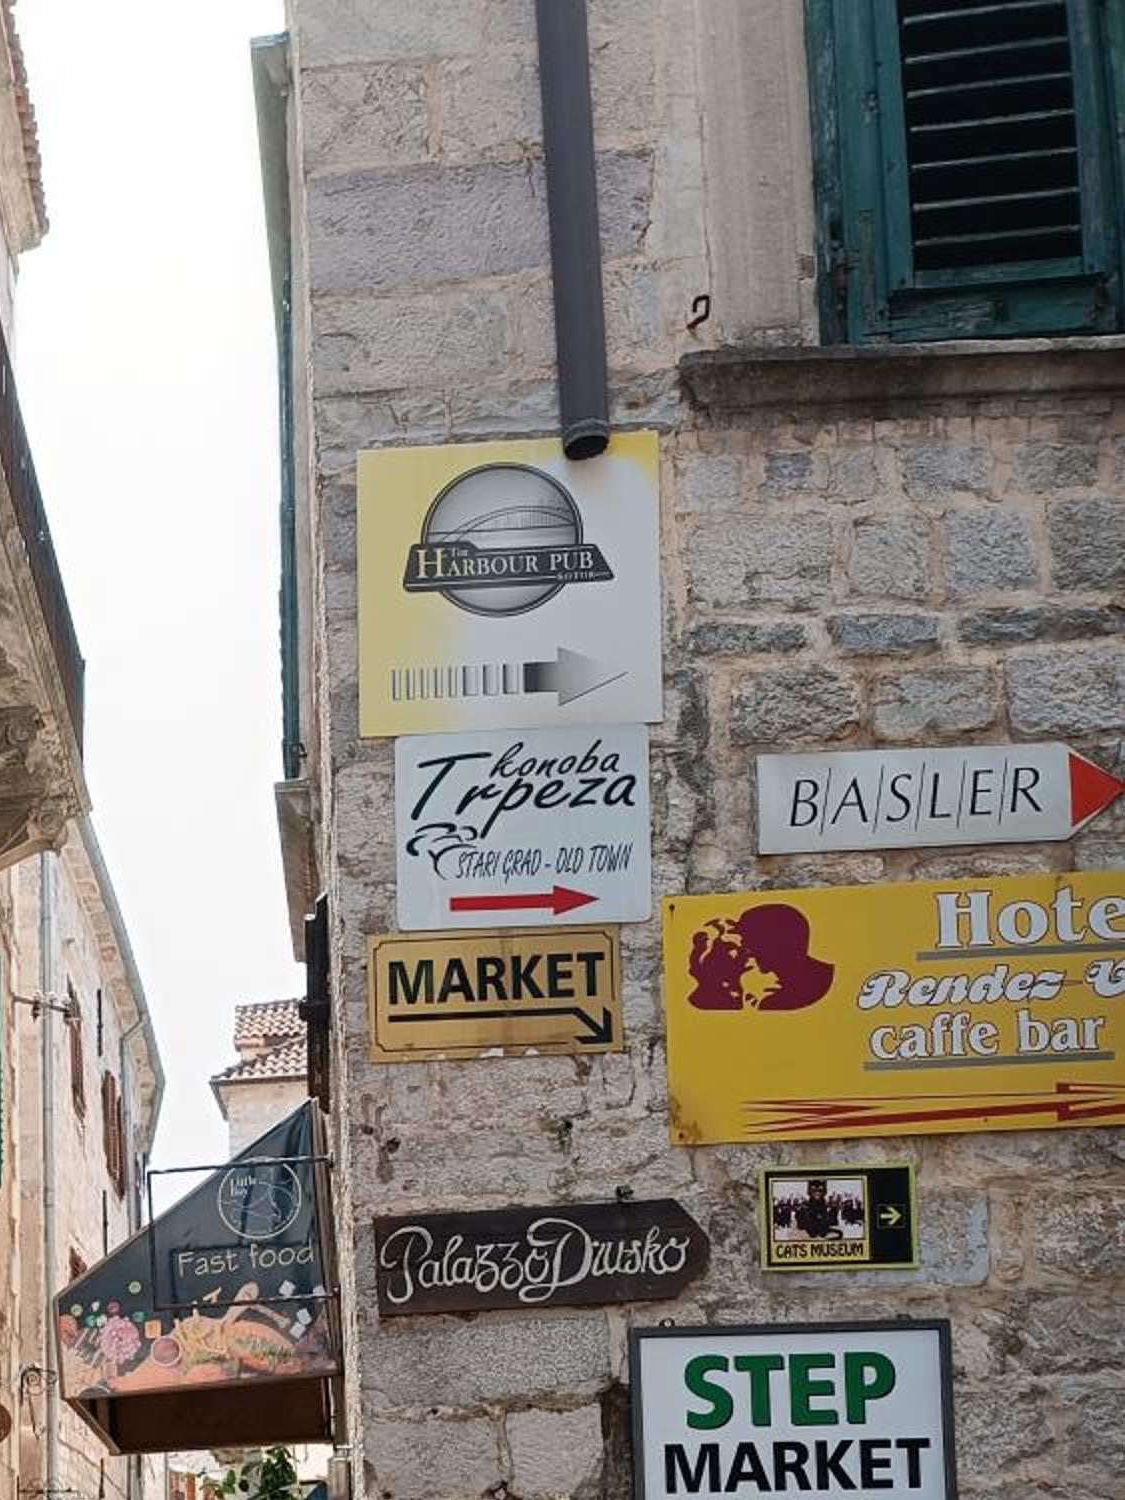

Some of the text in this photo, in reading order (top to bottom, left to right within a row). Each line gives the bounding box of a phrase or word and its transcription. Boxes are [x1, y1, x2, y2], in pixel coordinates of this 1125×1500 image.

[416, 548, 594, 579] HARBOUR PUB
[489, 740, 620, 779] konoba
[410, 752, 637, 839] Trpeza
[456, 850, 500, 879] STARI
[502, 848, 542, 884] GRAD
[556, 846, 584, 874] OLD
[588, 842, 633, 873] TOWN
[933, 884, 1125, 949] Hote
[388, 952, 605, 1005] MARKET
[869, 1008, 1106, 1061] caffe bar
[177, 1238, 315, 1278] Fast food
[380, 1225, 551, 1303] Palazzo
[776, 1242, 864, 1259] CATS MUSEUM
[683, 1350, 897, 1431] STEP
[663, 1436, 931, 1494] MARKET
